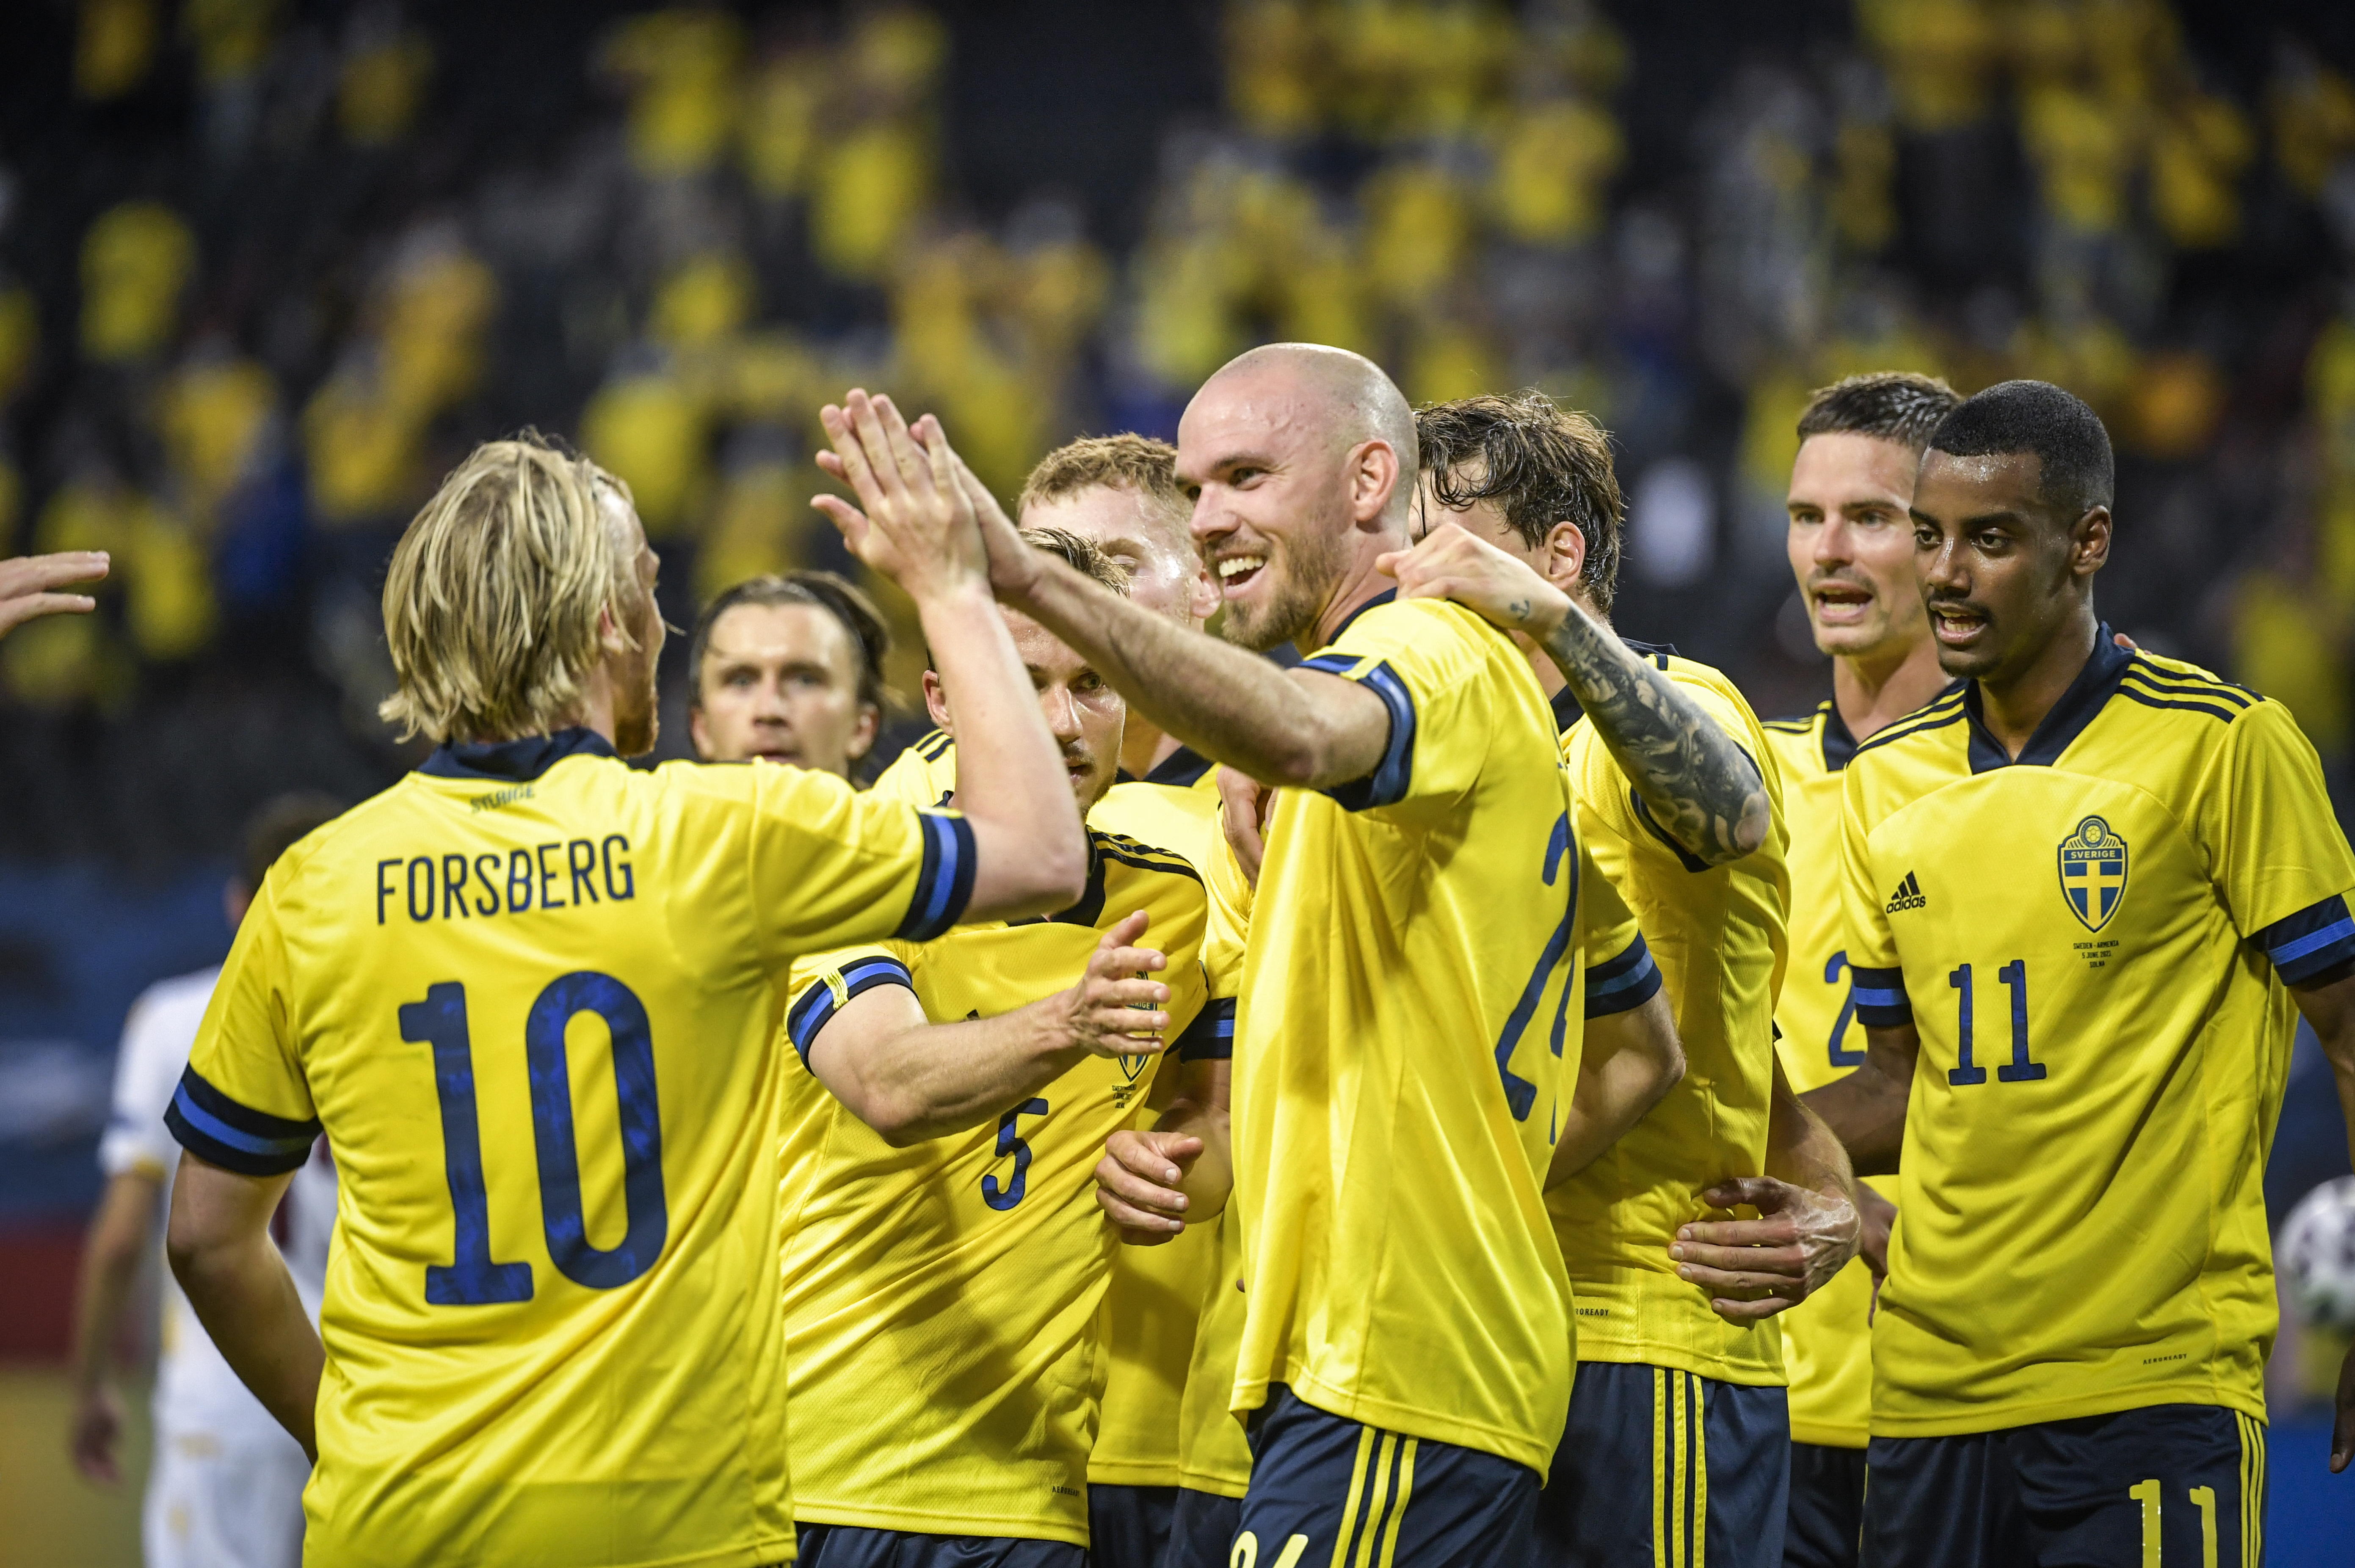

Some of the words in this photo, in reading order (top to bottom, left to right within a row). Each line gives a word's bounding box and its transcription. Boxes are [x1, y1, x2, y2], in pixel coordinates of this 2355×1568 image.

[378, 835, 634, 925] FORSBERG
[2071, 850, 2115, 859] SVERIGE
[1886, 896, 1926, 914] adidas
[1948, 959, 2047, 1086] 11
[398, 970, 668, 1306] 10
[982, 1097, 1049, 1211] 5
[2143, 1353, 2187, 1365] AEROREADY
